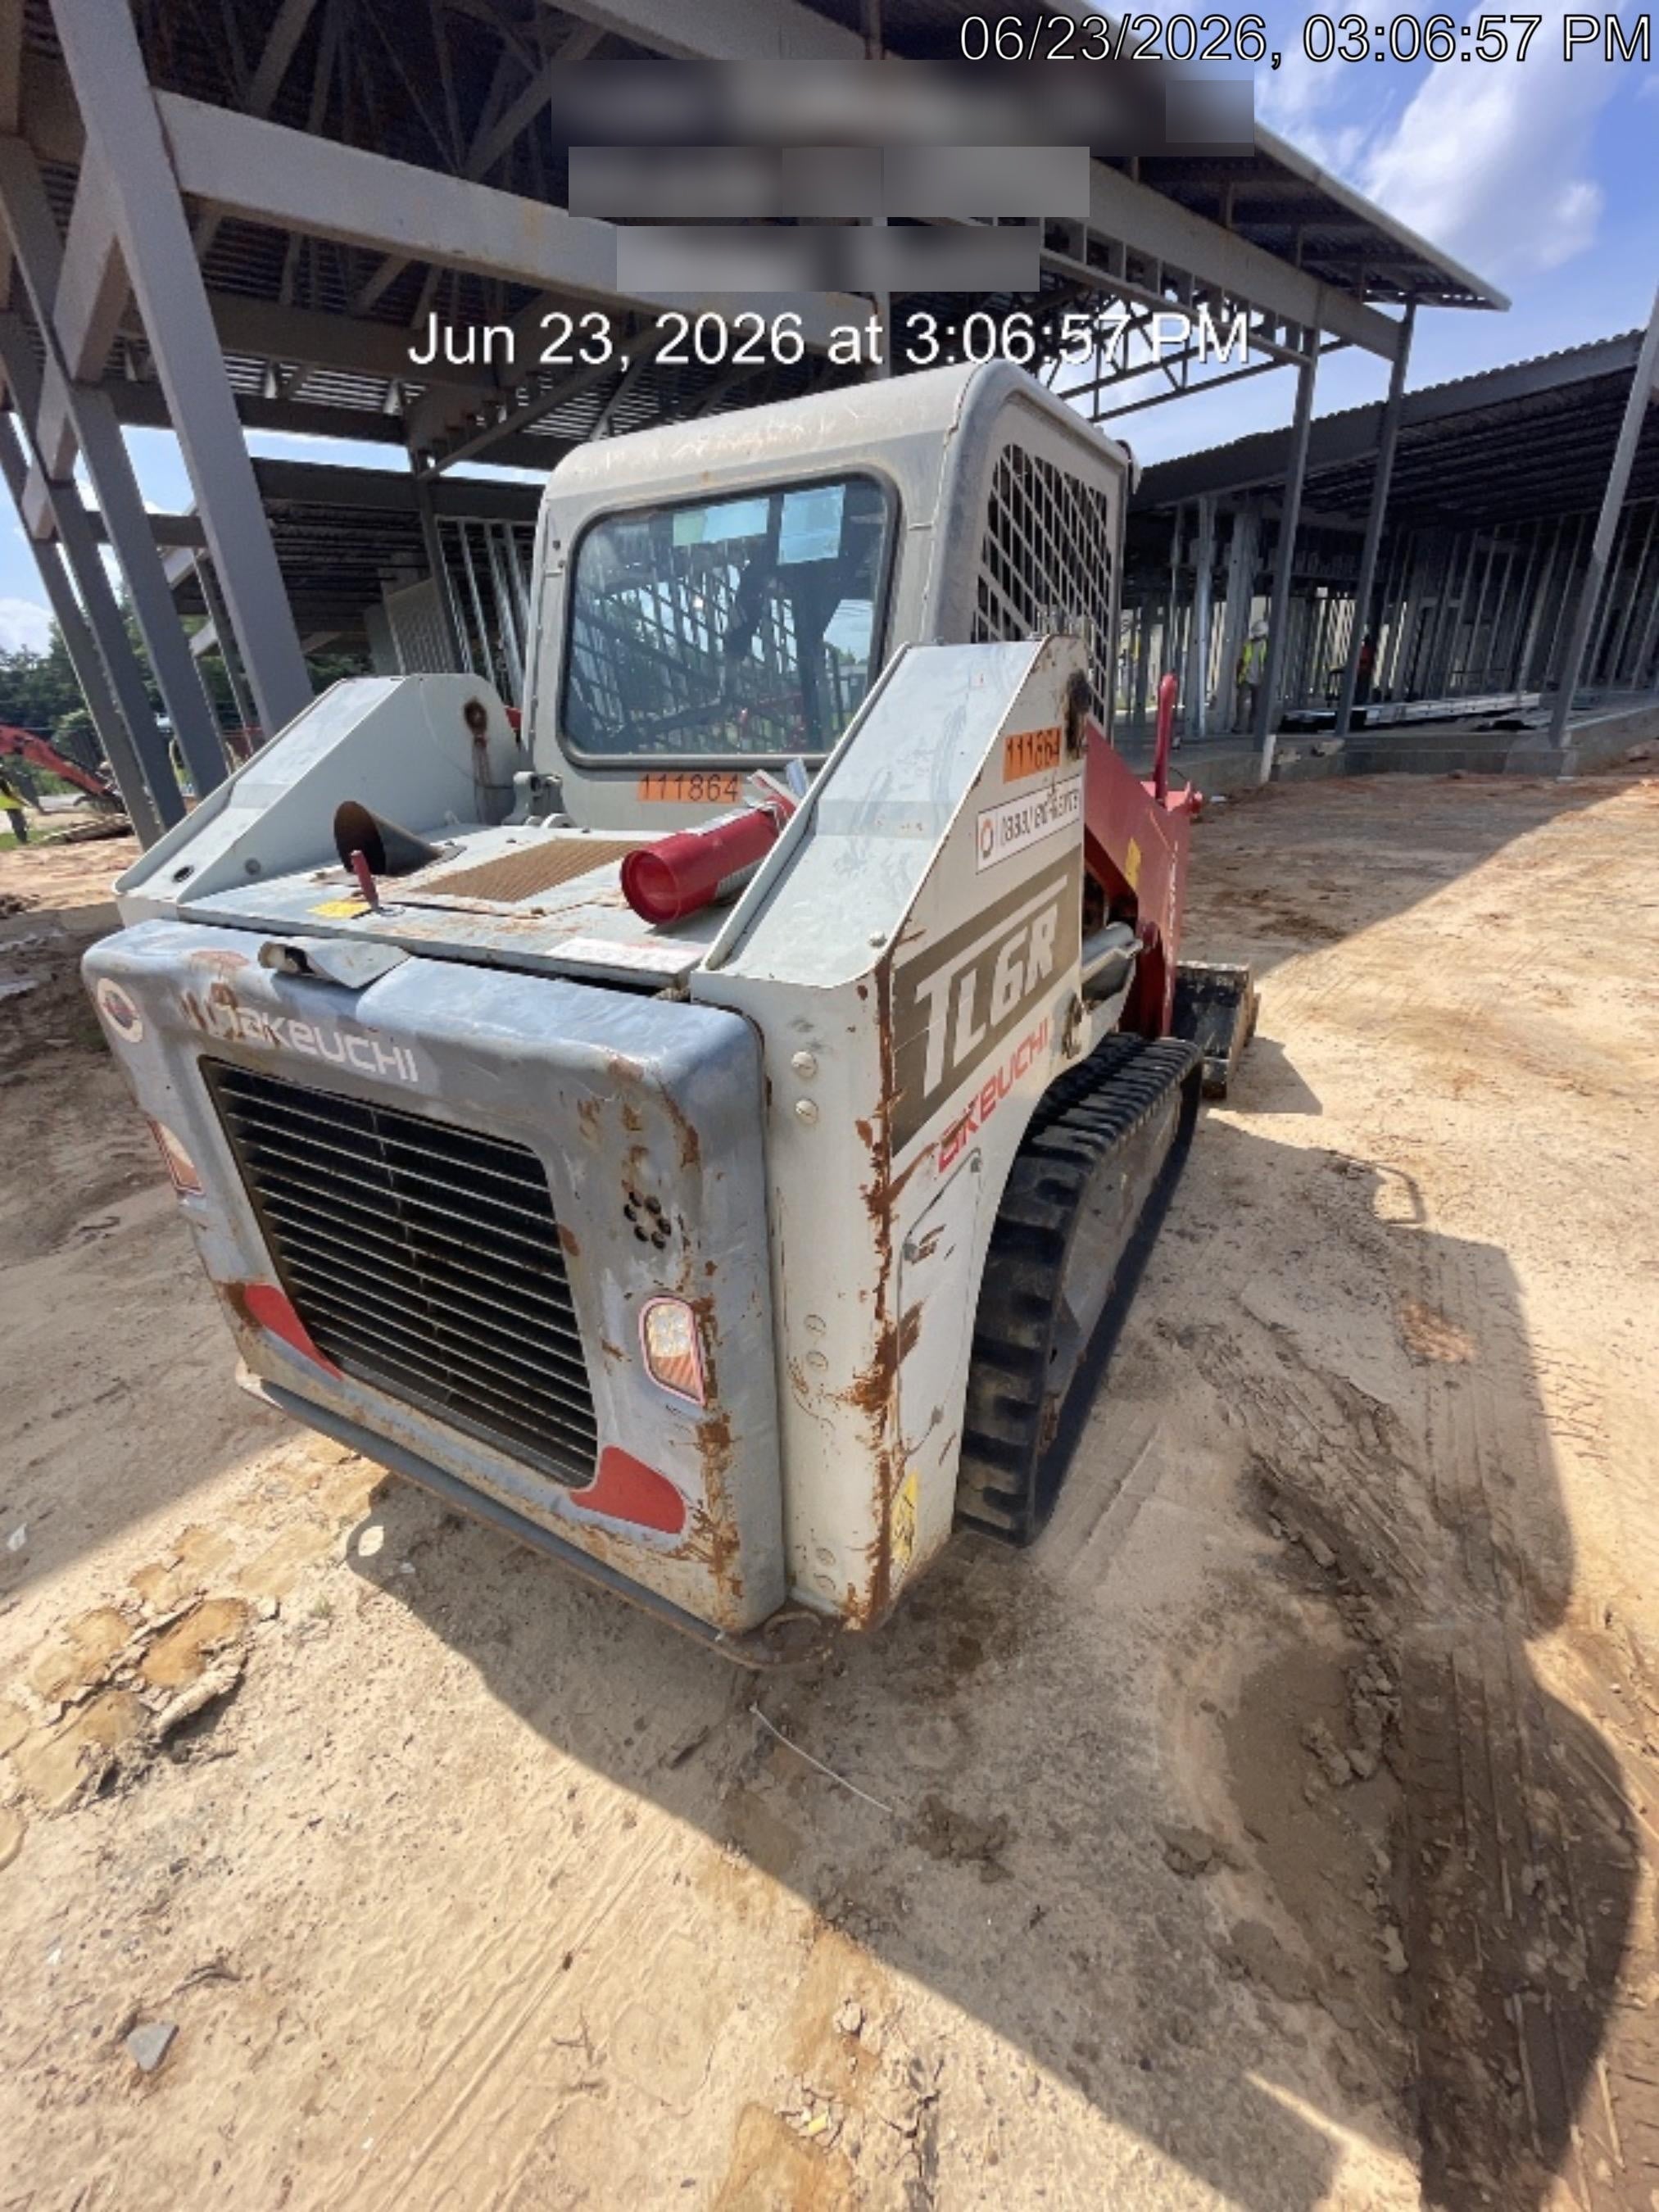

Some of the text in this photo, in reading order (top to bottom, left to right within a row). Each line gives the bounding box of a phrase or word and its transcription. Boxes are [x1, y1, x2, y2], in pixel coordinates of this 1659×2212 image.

[1007, 728, 1061, 770] 111864
[640, 773, 740, 802] 111864
[913, 876, 1067, 1099] TL6R
